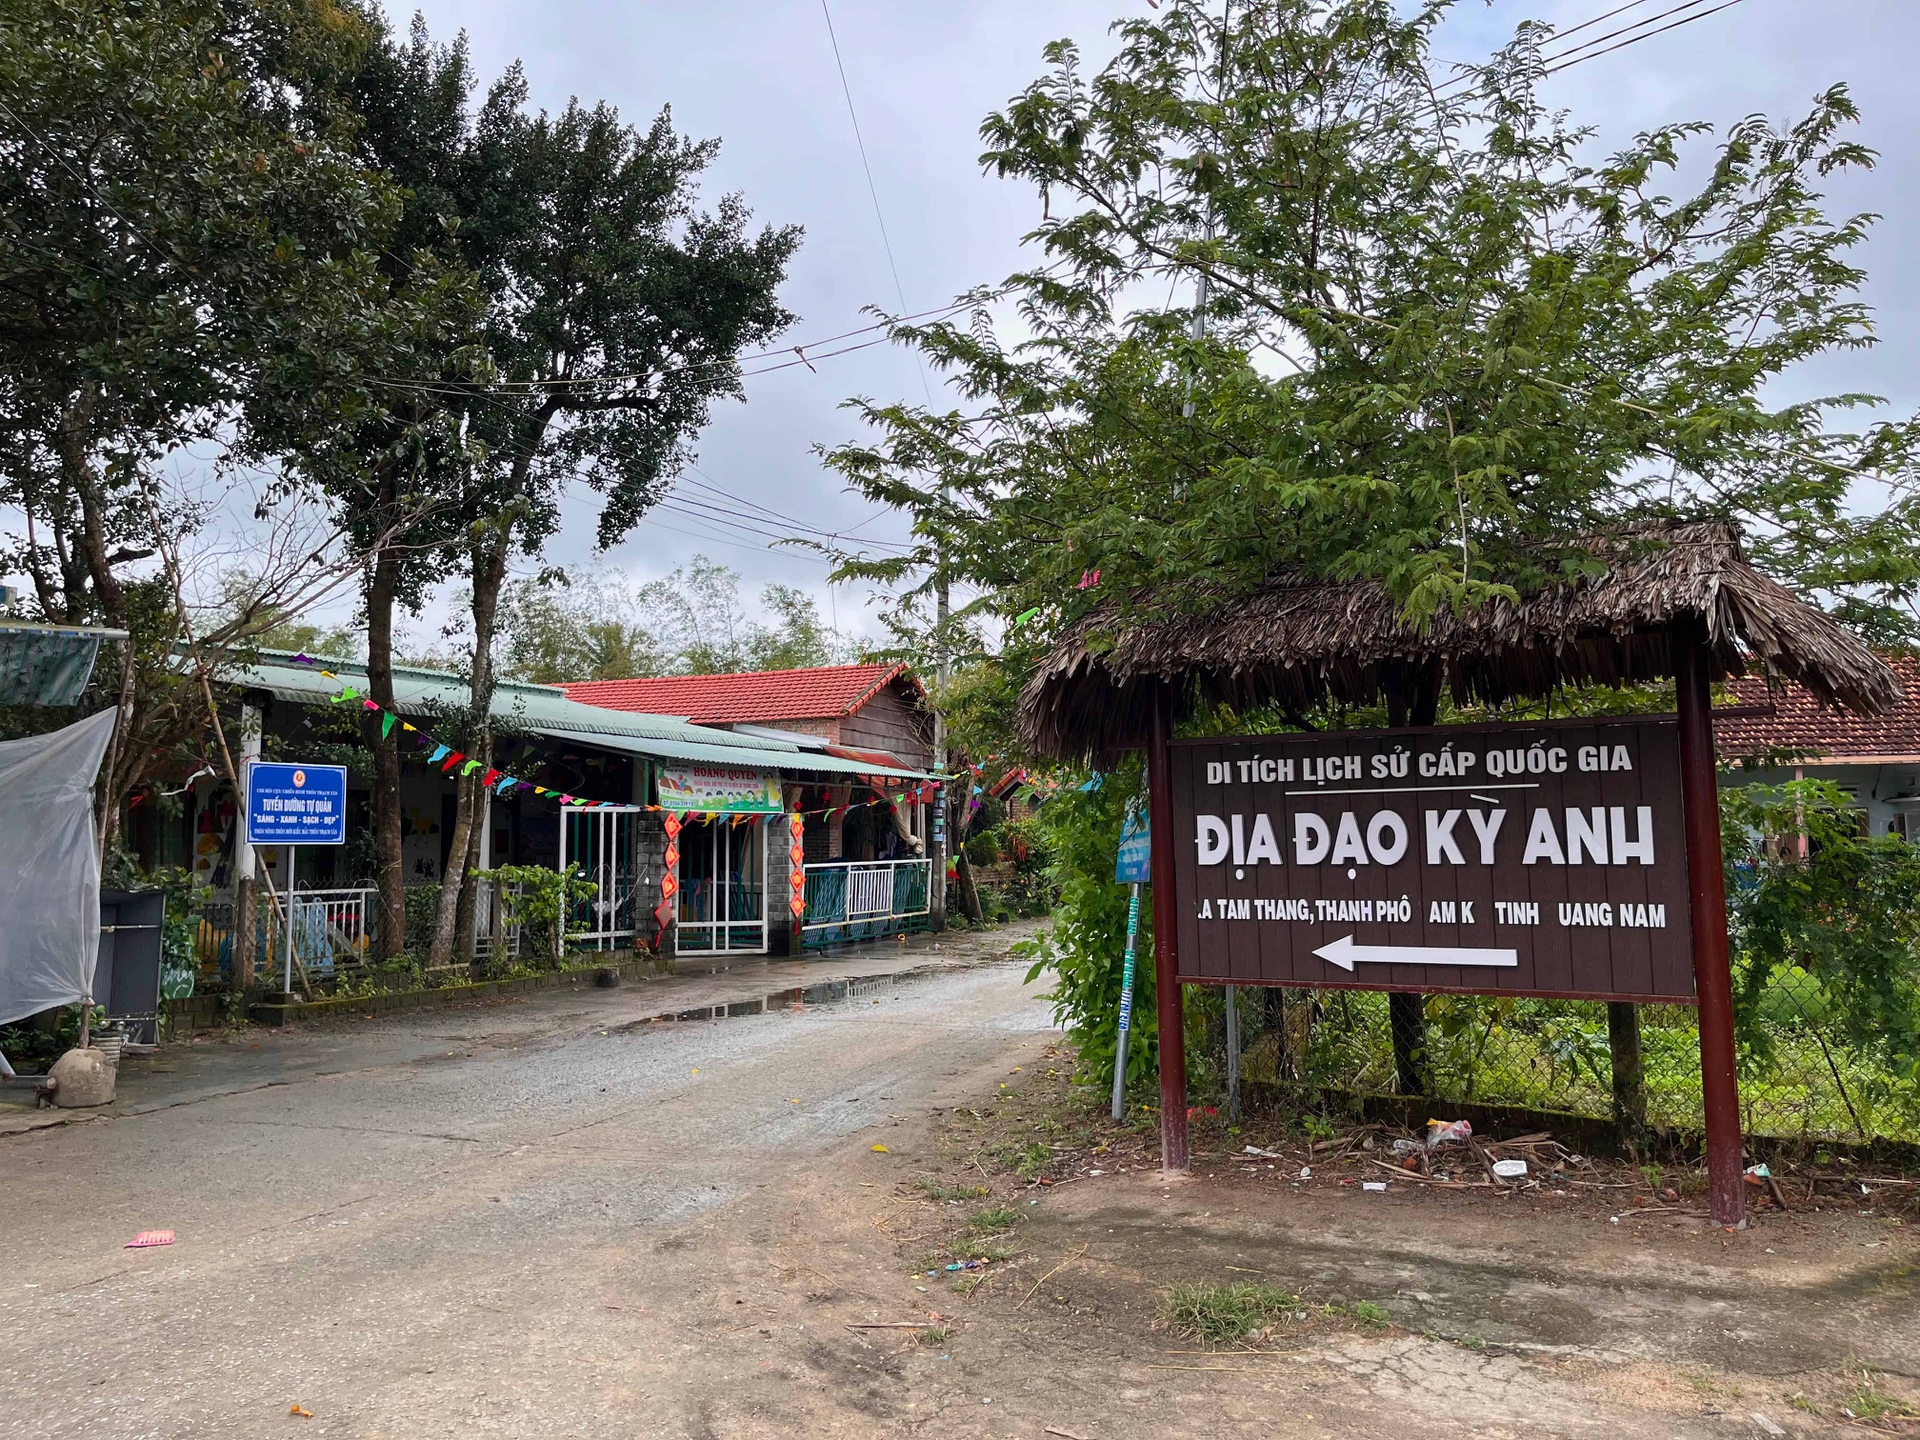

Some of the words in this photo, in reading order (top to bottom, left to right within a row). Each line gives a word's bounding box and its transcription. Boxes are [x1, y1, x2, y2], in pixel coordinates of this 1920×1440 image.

[1207, 762, 1232, 784] DI
[1237, 754, 1295, 783] TÍCH
[1303, 755, 1362, 785] LỊCH
[1371, 745, 1410, 778] SỬ
[1419, 742, 1476, 777] CẤP
[1486, 739, 1567, 777] QUỐC
[1578, 745, 1633, 772] GIA
[280, 815, 297, 823] XANH
[1195, 814, 1283, 880] ĐỊA
[1292, 810, 1408, 880] ĐẠO
[1425, 794, 1507, 865] KỲ
[1522, 806, 1655, 865] ANH
[1217, 899, 1250, 920] TAM
[1620, 903, 1665, 928] NAM
